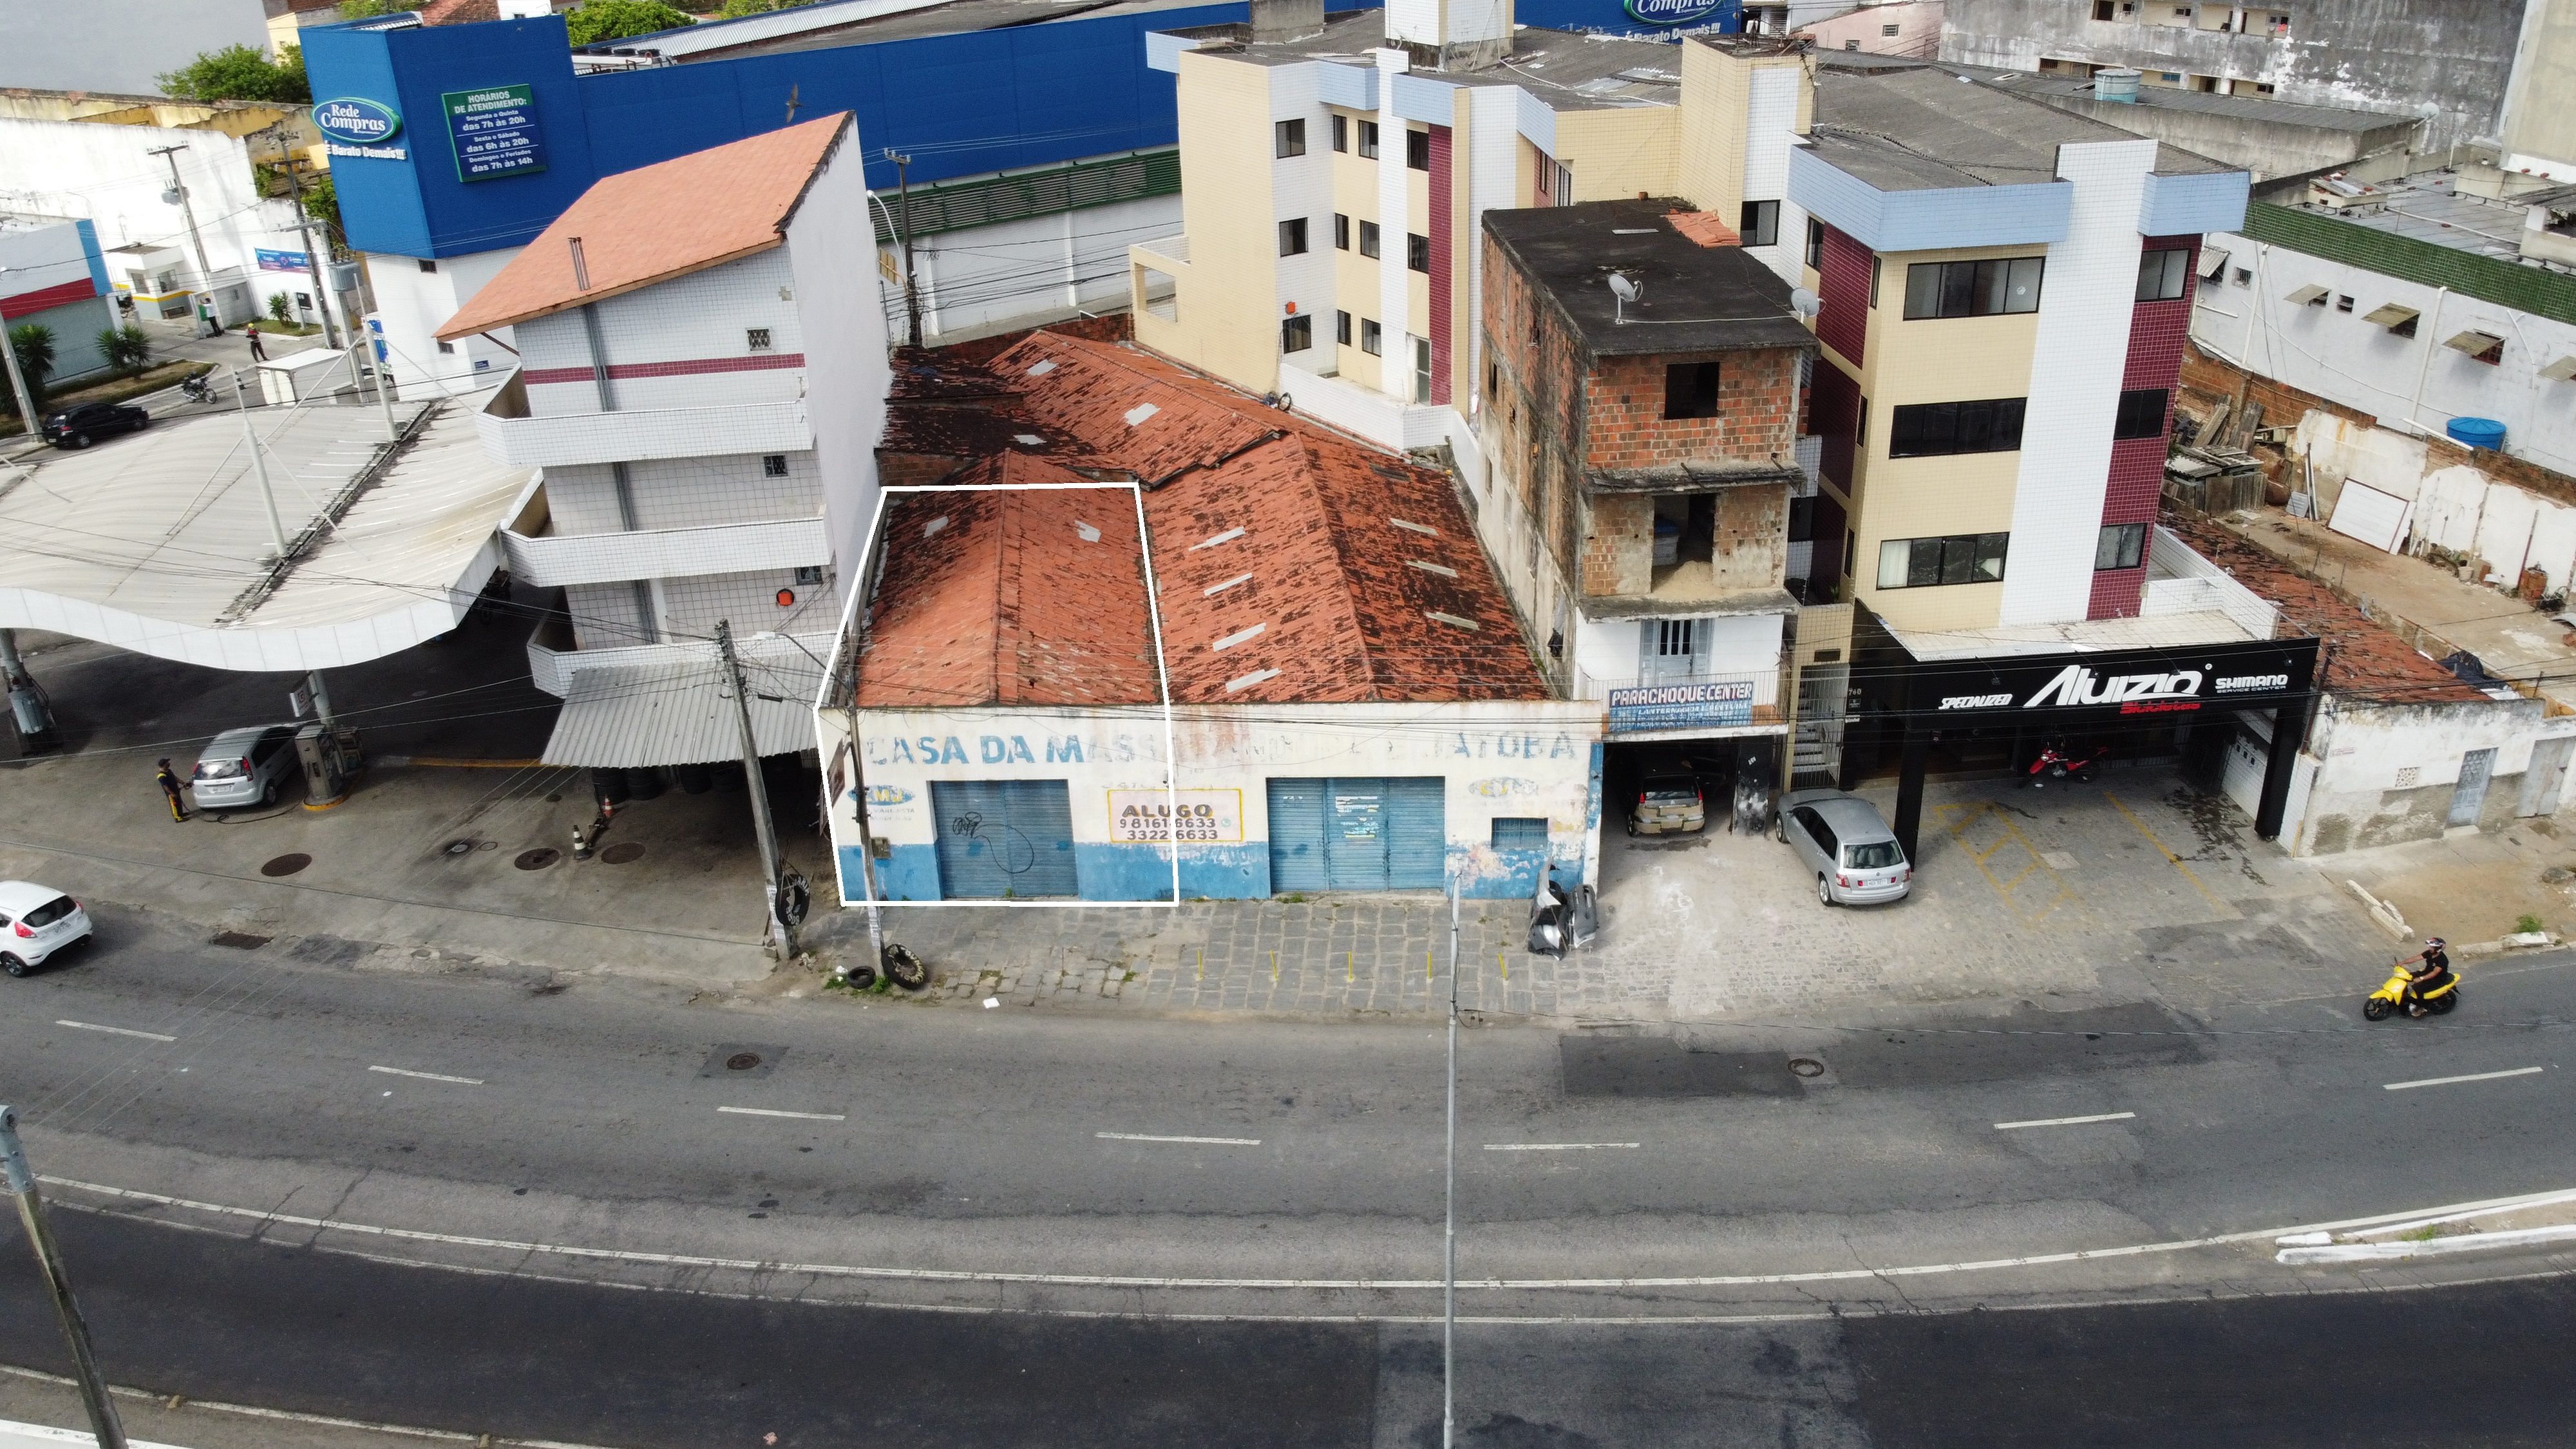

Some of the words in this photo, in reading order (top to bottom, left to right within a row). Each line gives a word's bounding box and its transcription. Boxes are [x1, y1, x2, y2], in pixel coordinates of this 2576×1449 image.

[468, 91, 510, 103] HORÁRIOS
[331, 104, 359, 117] Rede
[454, 106, 466, 114] DE
[468, 98, 527, 112] ATENDIMENTO:
[321, 113, 386, 133] Compras
[482, 120, 493, 129] 7h
[509, 116, 526, 124] 20h
[513, 138, 529, 146] 20h
[332, 144, 361, 156] Barato
[518, 156, 533, 165] 14h
[2215, 674, 2288, 690] SHIMANO
[1612, 686, 1705, 706] PARACHOQUE
[1706, 683, 1752, 701] CENTER
[1938, 694, 2013, 710] SPECIALIZED
[867, 736, 970, 764] CASA
[980, 735, 1036, 764] DA
[1122, 804, 1213, 819] ALUGO
[1120, 819, 1126, 828] 9
[1127, 830, 1218, 840] 33226633
